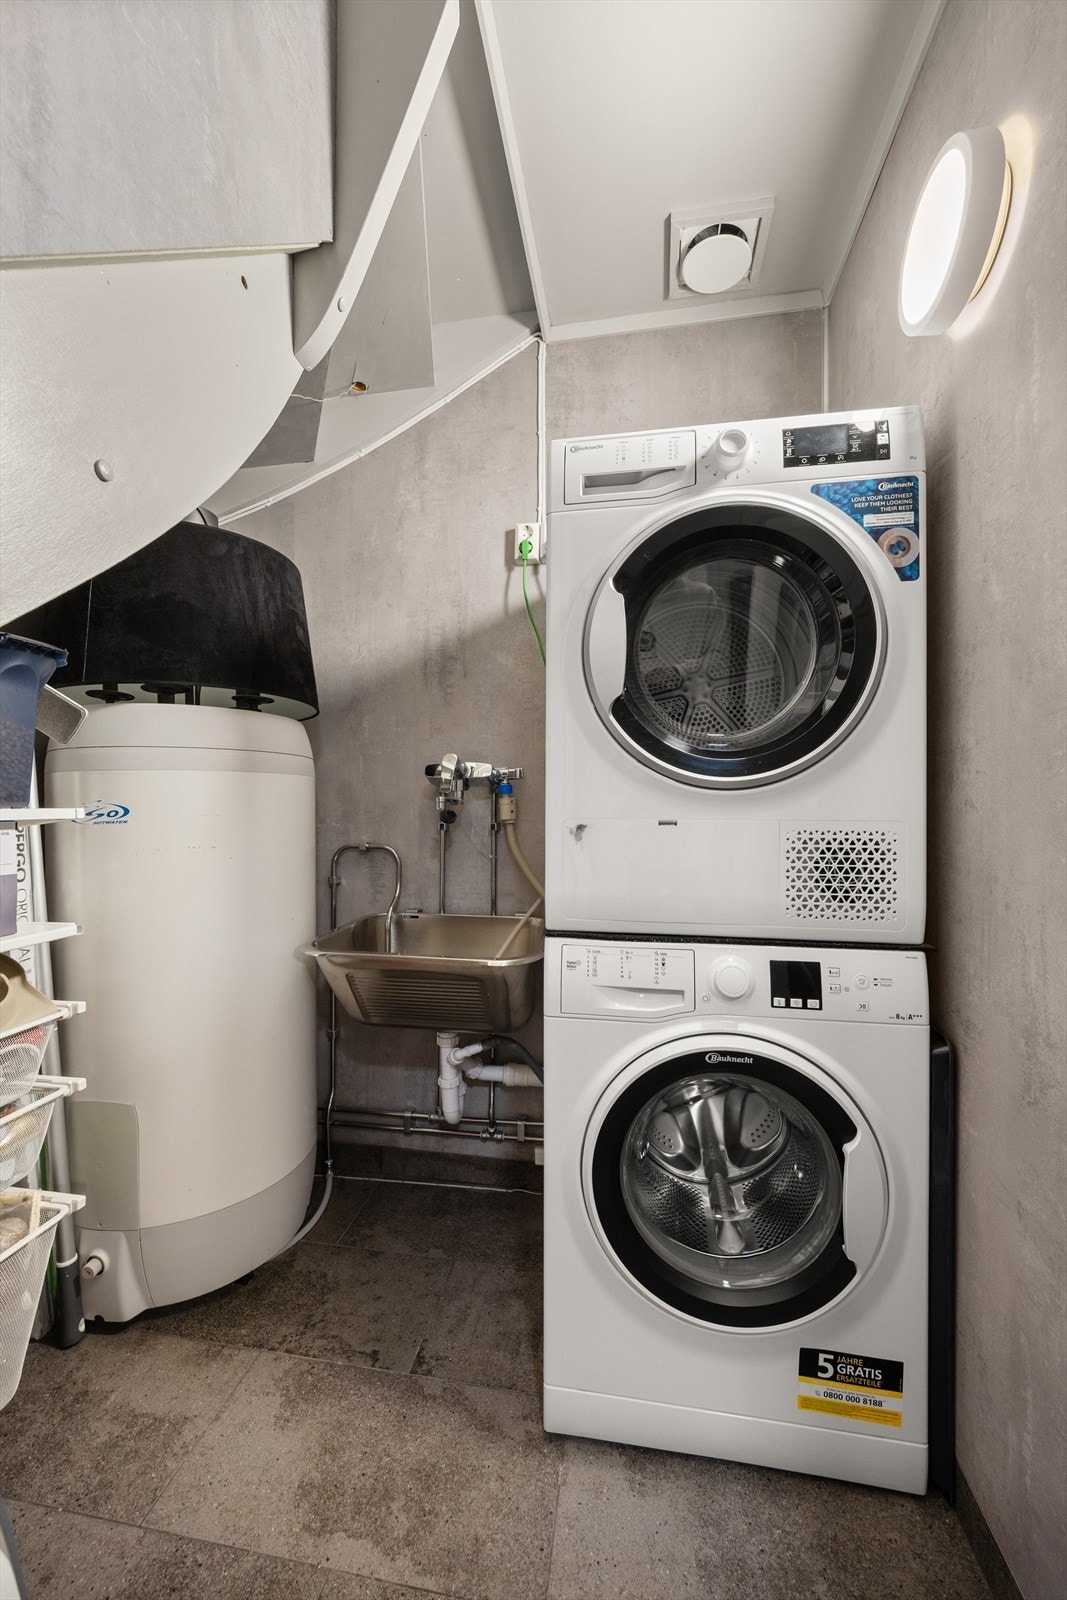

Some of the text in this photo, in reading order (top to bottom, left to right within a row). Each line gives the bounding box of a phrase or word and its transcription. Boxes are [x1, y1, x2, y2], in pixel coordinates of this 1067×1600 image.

[878, 481, 914, 491] Bauknecht
[705, 1052, 754, 1064] Bauknecht
[817, 1353, 834, 1378] 5
[836, 1356, 863, 1367] JAHRE
[836, 1363, 882, 1380] GRATIS
[823, 1390, 844, 1401] 0800
[845, 1394, 861, 1404] 000
[862, 1397, 883, 1408] 8188
